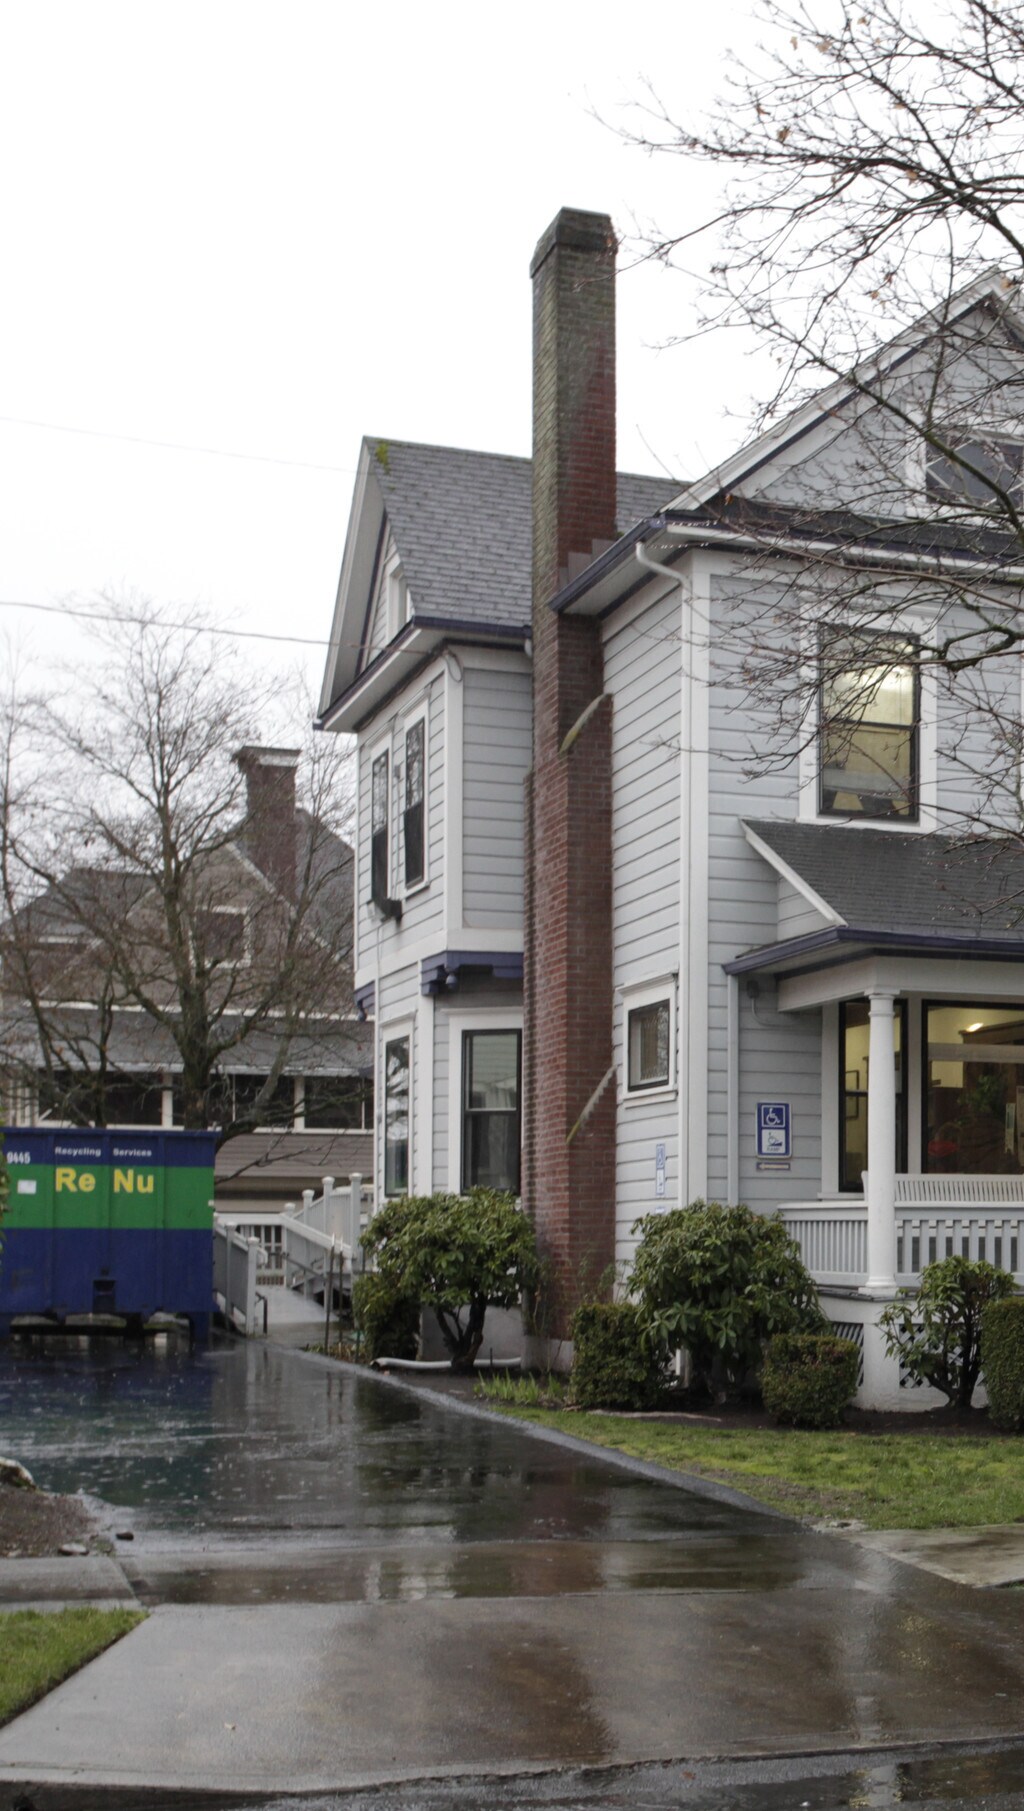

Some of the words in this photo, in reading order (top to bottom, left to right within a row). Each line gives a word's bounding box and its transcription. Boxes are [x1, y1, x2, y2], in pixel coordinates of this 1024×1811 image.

[55, 1146, 101, 1157] Recycling
[113, 1147, 152, 1157] Services
[55, 1168, 96, 1192] Re
[113, 1168, 154, 1193] Nu
